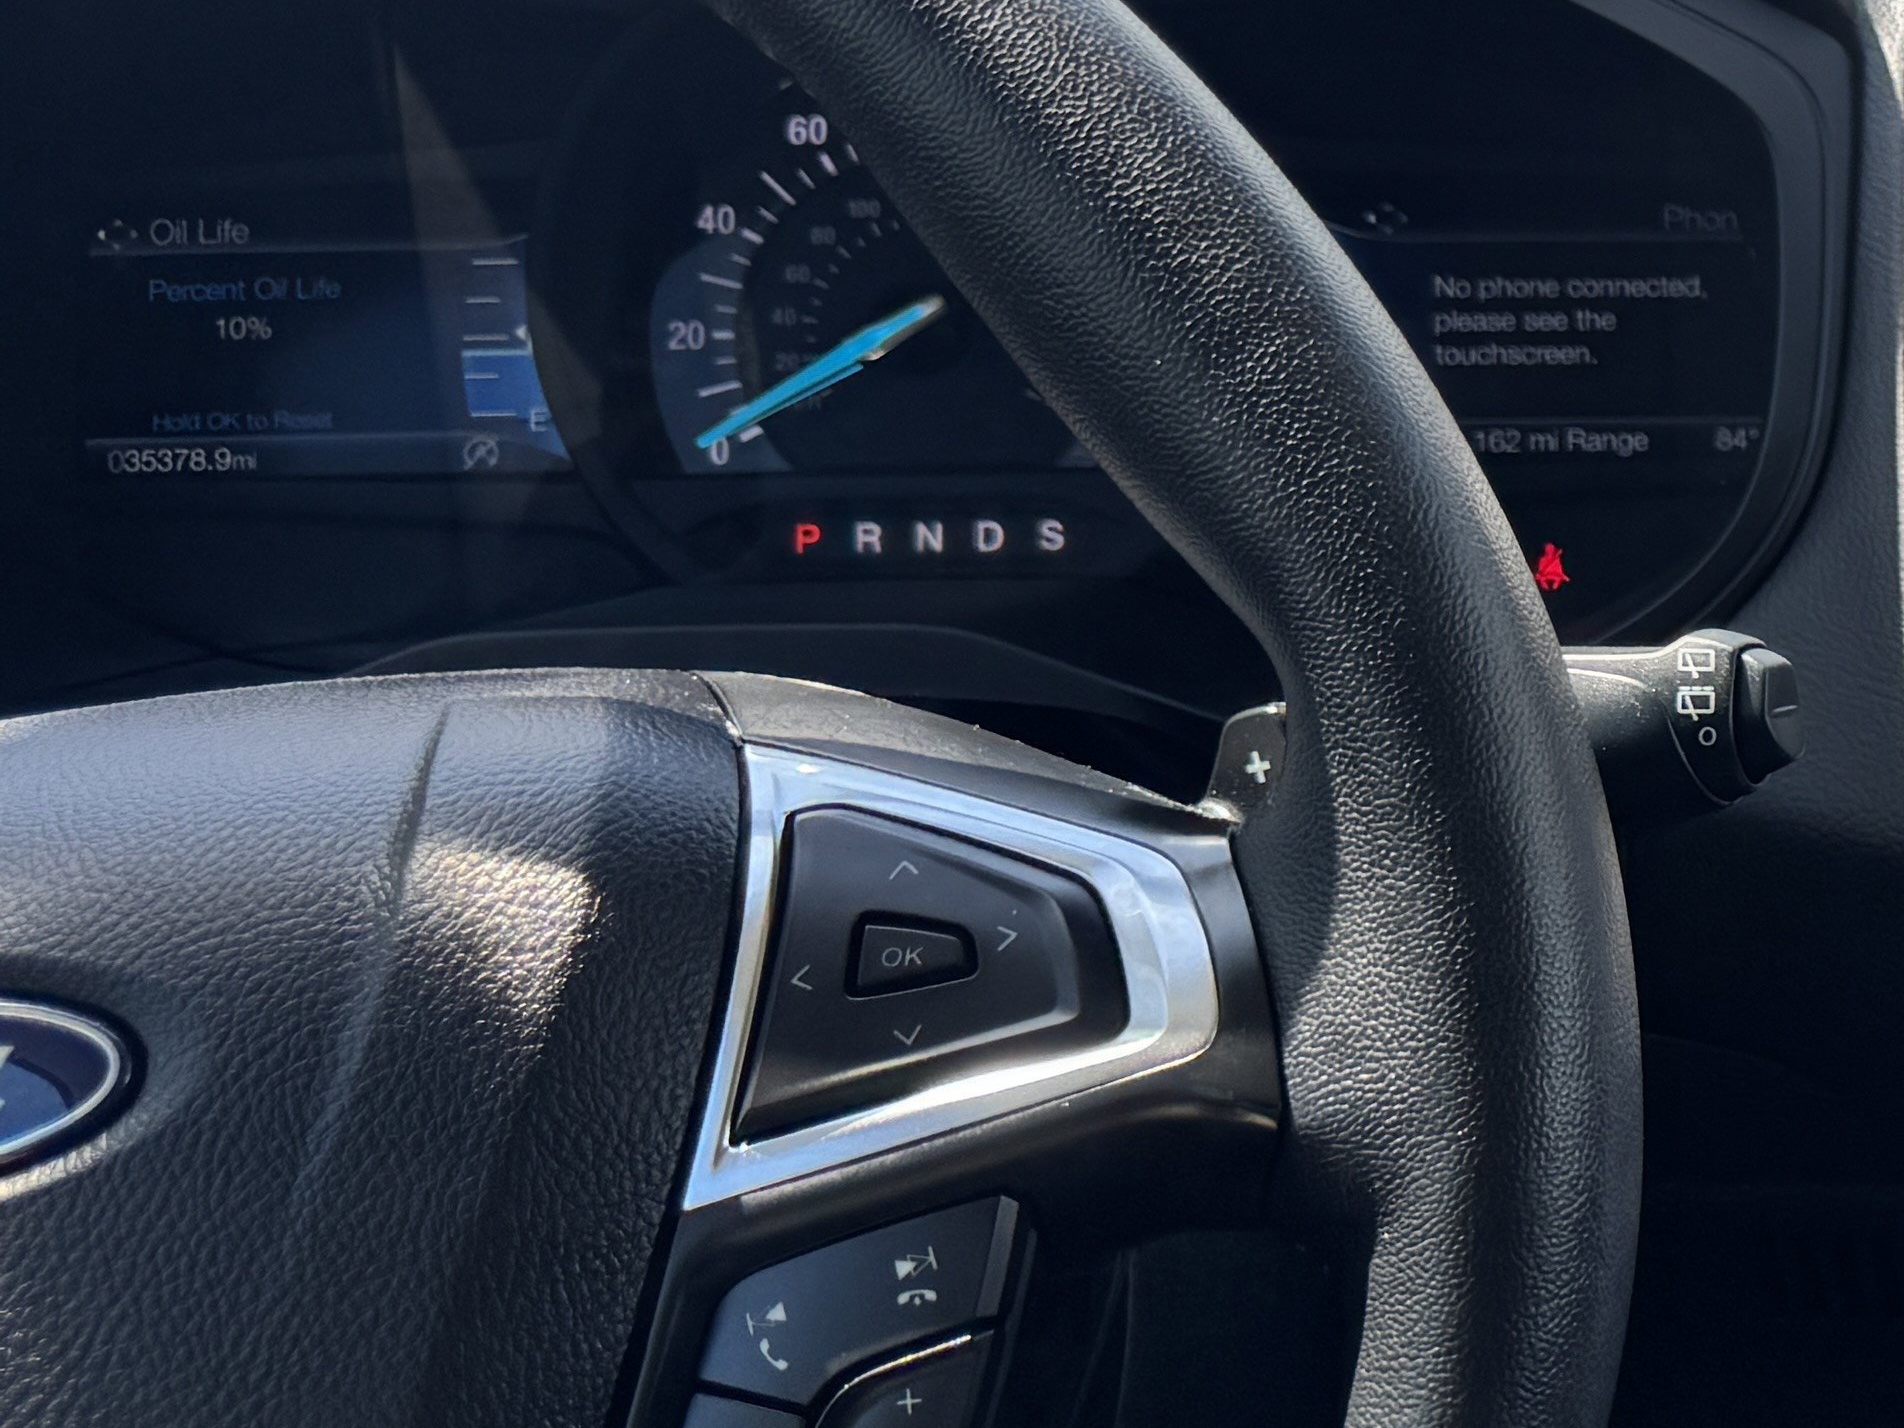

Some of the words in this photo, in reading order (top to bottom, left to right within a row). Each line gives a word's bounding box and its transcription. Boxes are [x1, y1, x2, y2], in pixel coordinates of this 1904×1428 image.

[786, 115, 828, 145] 60
[149, 218, 188, 246] Oil
[199, 218, 250, 245] Life
[696, 204, 736, 235] 40
[148, 278, 246, 302] Percent
[254, 278, 284, 300] Oil
[296, 277, 342, 300] Life
[1433, 275, 1471, 299] No
[1477, 275, 1561, 302] phone
[215, 316, 273, 340] 10%
[667, 319, 705, 351] 20
[1433, 308, 1517, 337] please
[1522, 311, 1569, 332] see
[1575, 307, 1617, 332] the
[1434, 342, 1599, 366] touchscreen.
[207, 412, 240, 430] OK
[1475, 429, 1521, 453] 162
[1529, 429, 1560, 452] mi
[1567, 427, 1650, 458] Range
[794, 522, 821, 554] P
[854, 521, 882, 553] R
[914, 520, 944, 553] N
[973, 520, 1005, 553] D
[1037, 519, 1065, 551] S
[881, 945, 925, 968] OK
